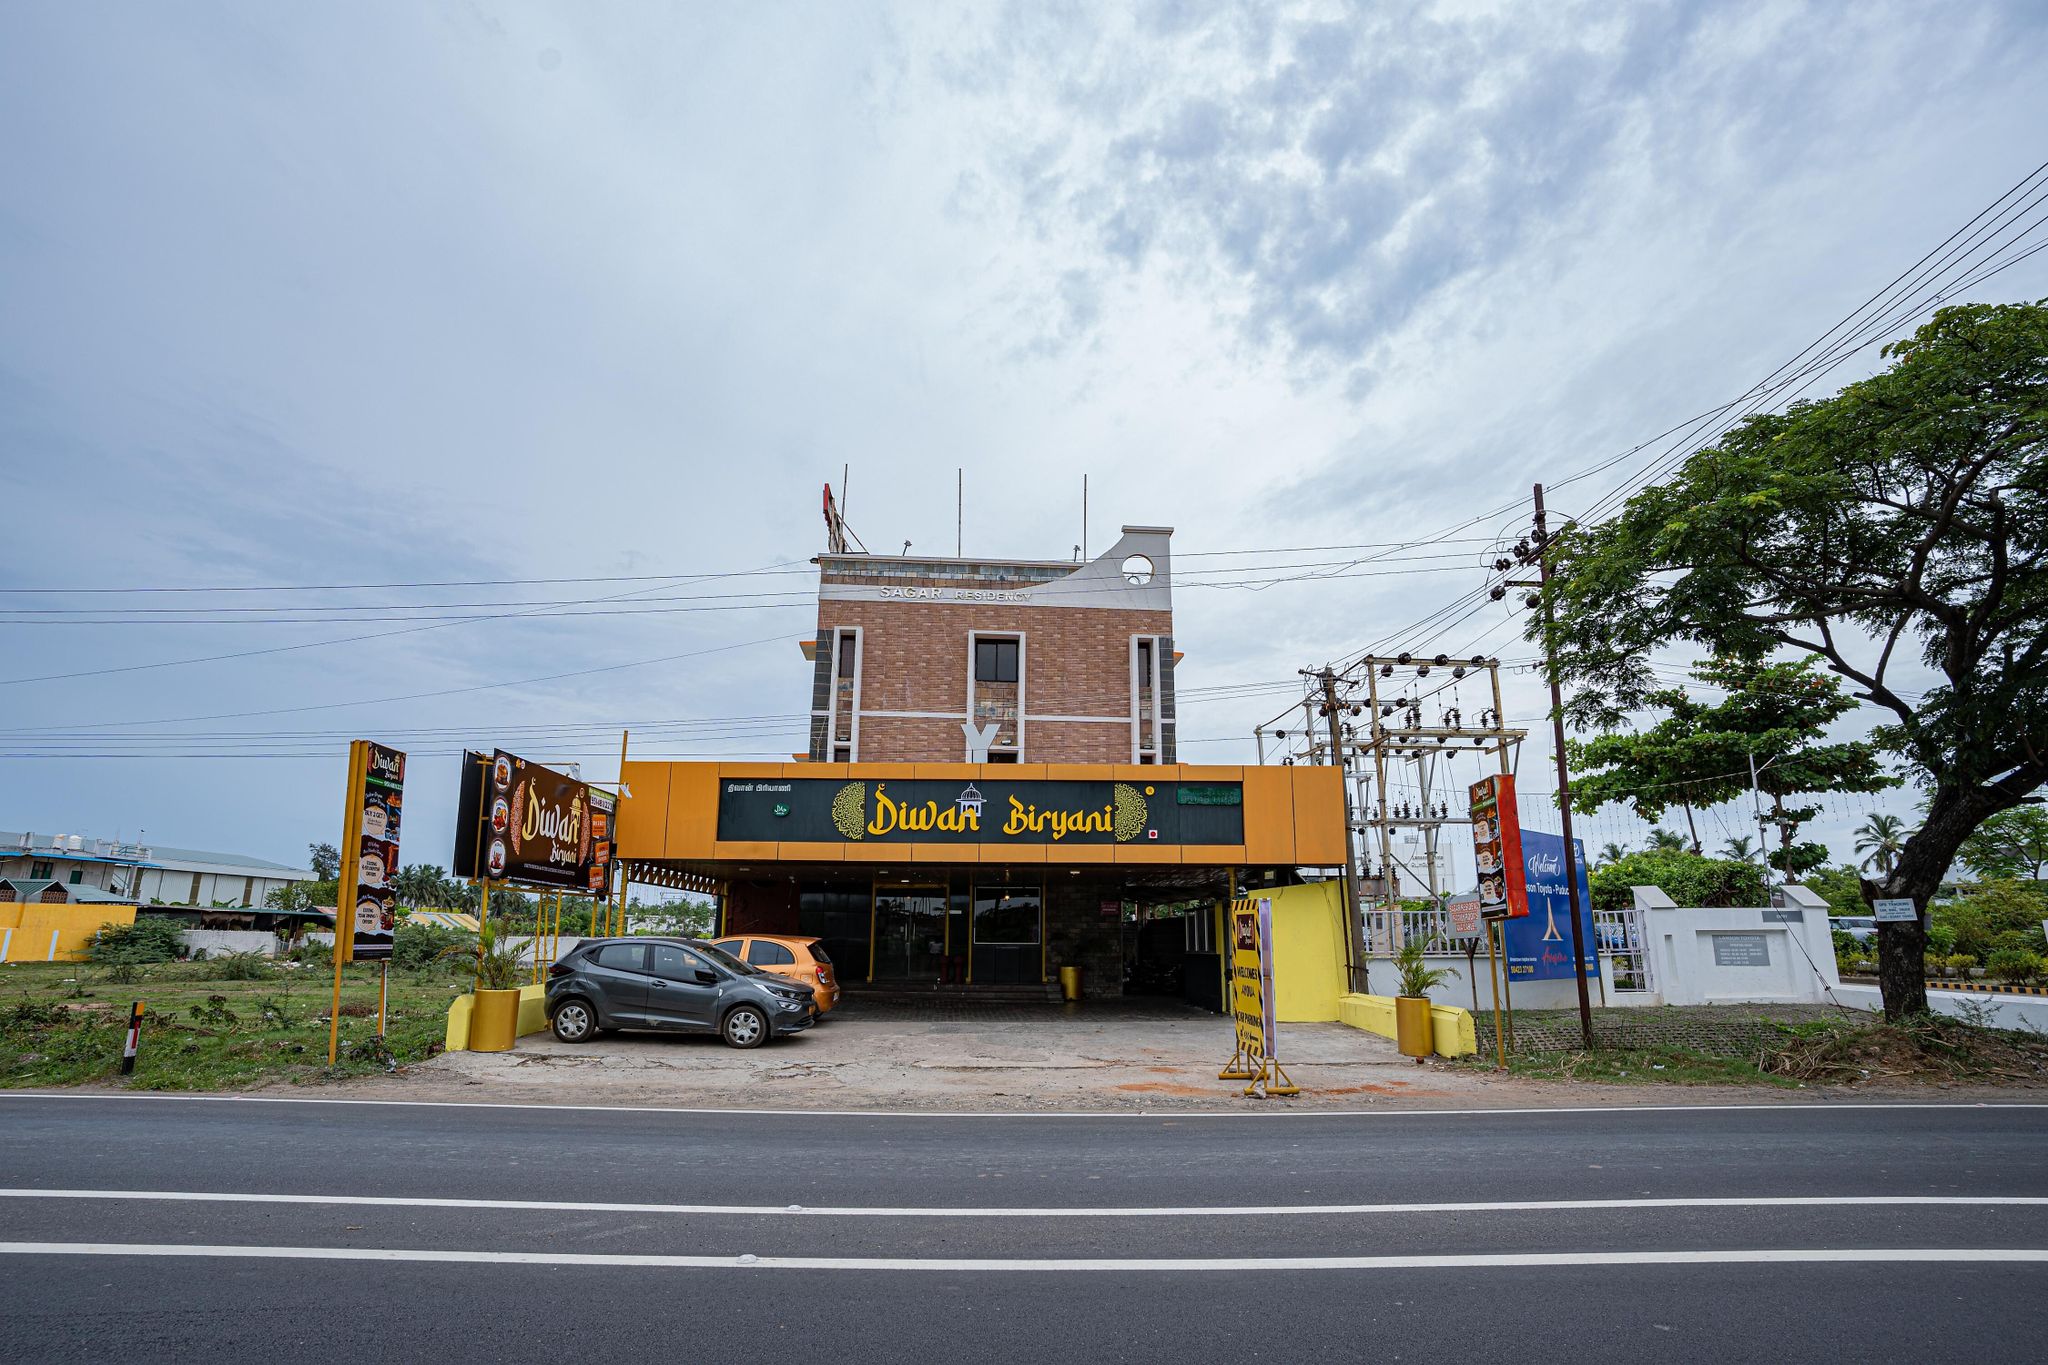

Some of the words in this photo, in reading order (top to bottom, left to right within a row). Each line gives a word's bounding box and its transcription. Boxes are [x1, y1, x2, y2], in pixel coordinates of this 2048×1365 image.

[880, 585, 942, 599] SAGAR
[955, 590, 1032, 602] RESIDENCY
[372, 747, 399, 773] Diwan
[522, 777, 579, 844] Diwan
[867, 783, 980, 835] Diwan
[1003, 794, 1114, 840] Biryani
[549, 840, 577, 866] Biryani
[1528, 853, 1560, 877] Welcome
[1537, 882, 1552, 896] Toyota
